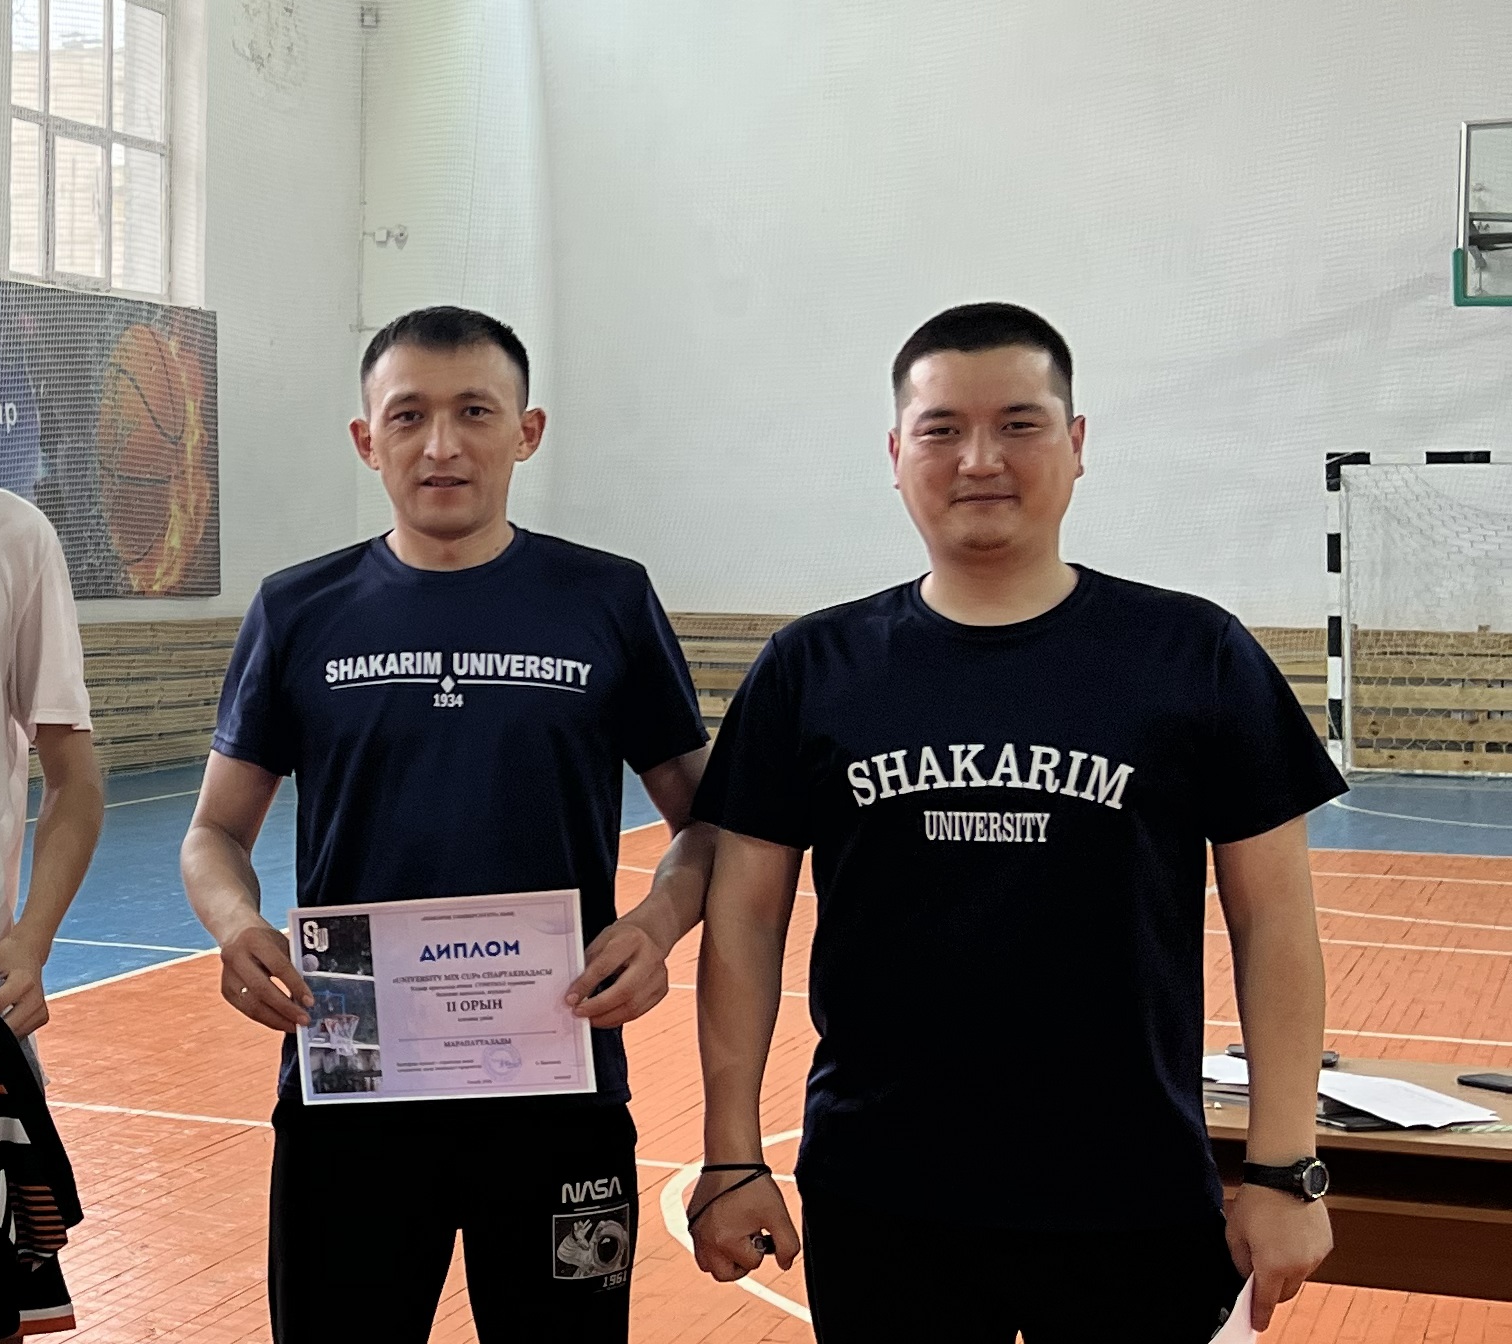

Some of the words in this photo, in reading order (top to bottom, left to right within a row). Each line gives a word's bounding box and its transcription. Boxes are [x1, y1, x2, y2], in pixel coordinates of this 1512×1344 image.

[325, 652, 443, 684] SHAKARIM
[452, 652, 592, 686] UNIVERSITY
[433, 693, 464, 708] 1934
[847, 742, 1135, 810] SHAKARIM
[923, 810, 1050, 843] UNIVERSITY
[419, 939, 521, 963] ДИПЛОМ
[460, 998, 503, 1012] ОРЫН
[561, 1176, 623, 1204] NASA
[602, 1269, 628, 1288] 1961
